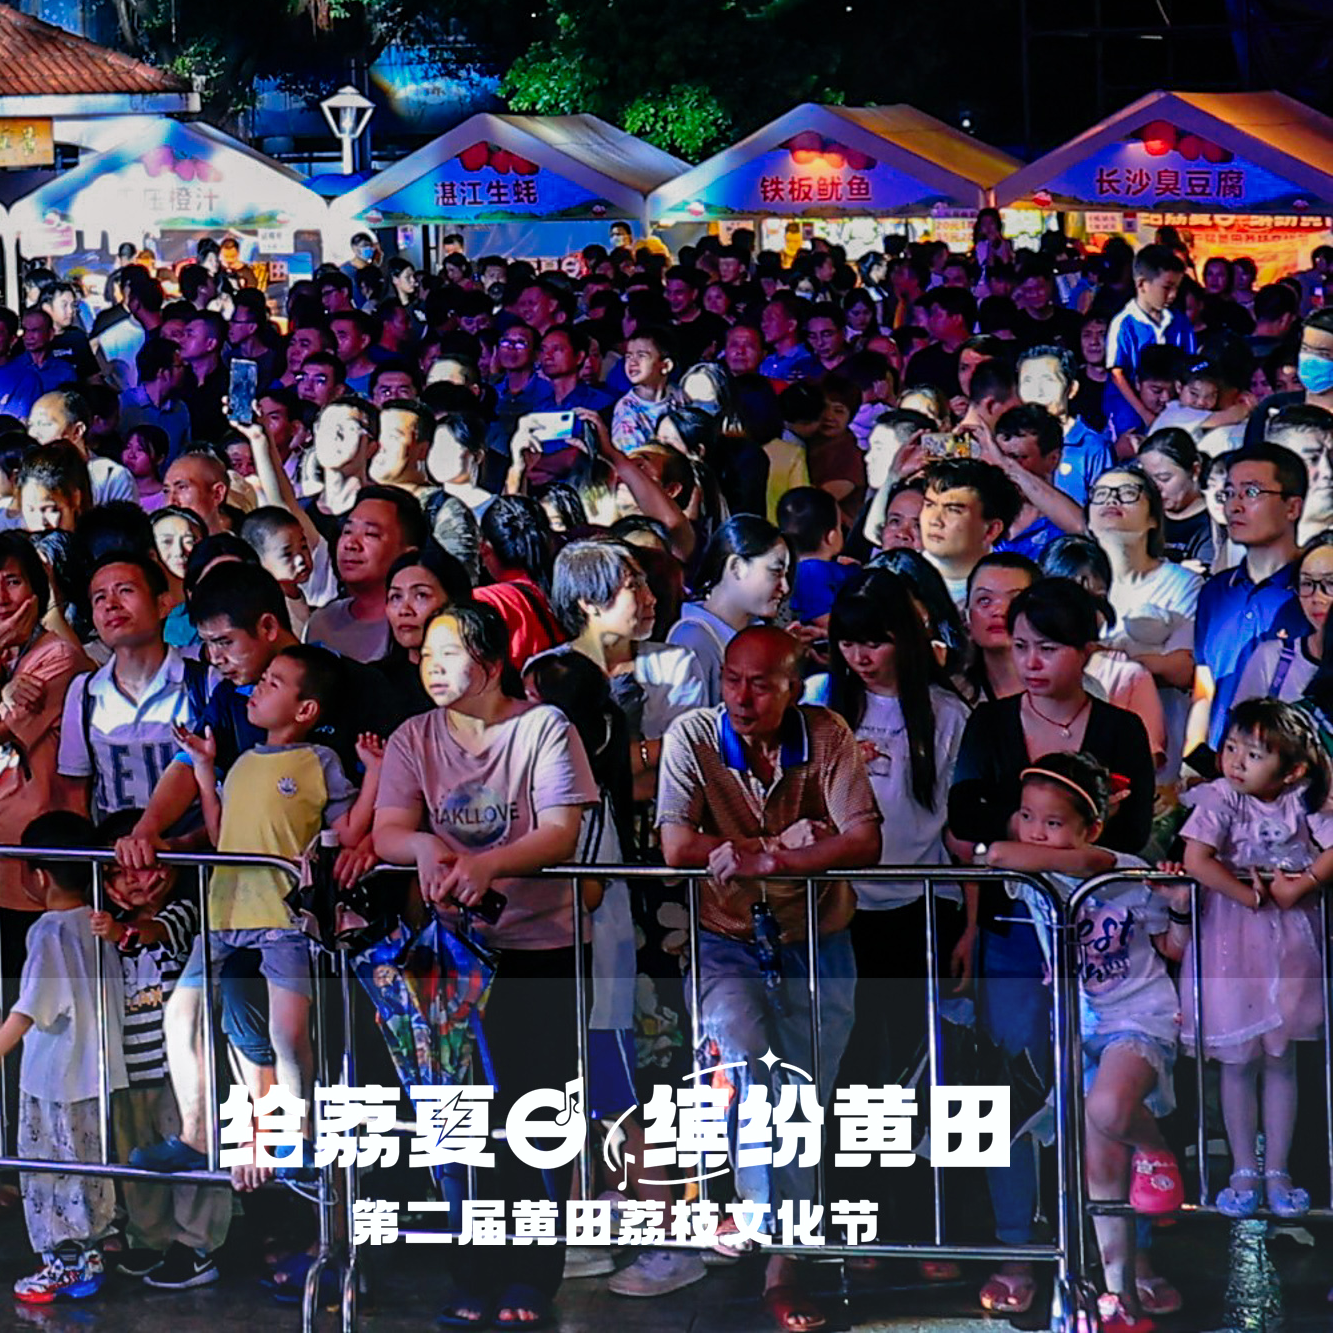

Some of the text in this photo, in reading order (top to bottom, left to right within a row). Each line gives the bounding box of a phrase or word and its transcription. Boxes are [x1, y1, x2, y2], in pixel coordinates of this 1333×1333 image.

[433, 180, 539, 207] 湛江生蚝
[760, 175, 872, 203] 铁板鱿鱼
[1095, 168, 1245, 198] 长沙臭豆腐
[116, 186, 221, 212] 压橙汁
